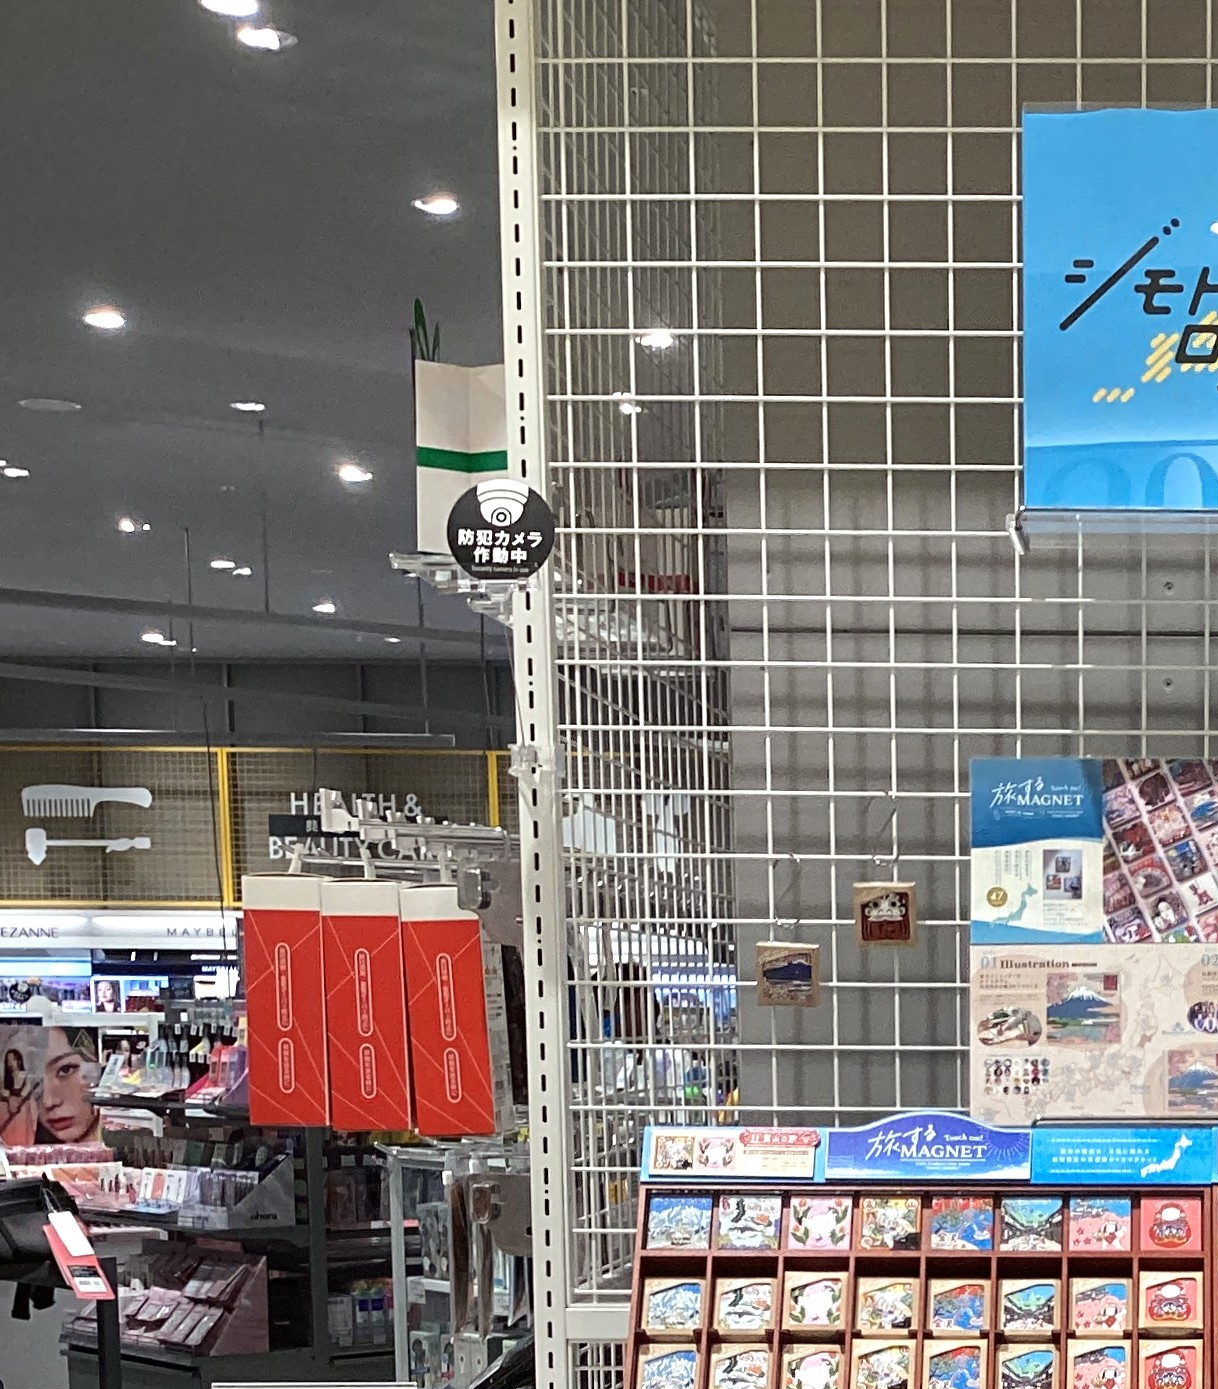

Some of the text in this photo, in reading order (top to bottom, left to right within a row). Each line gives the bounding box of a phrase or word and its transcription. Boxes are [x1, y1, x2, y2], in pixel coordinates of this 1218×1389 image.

[457, 528, 543, 547] 防犯カメラ
[473, 546, 528, 564] 作動中
[1016, 794, 1085, 807] MAGNET
[1000, 958, 1070, 969] Illustration
[900, 1144, 988, 1158] MAGNET
